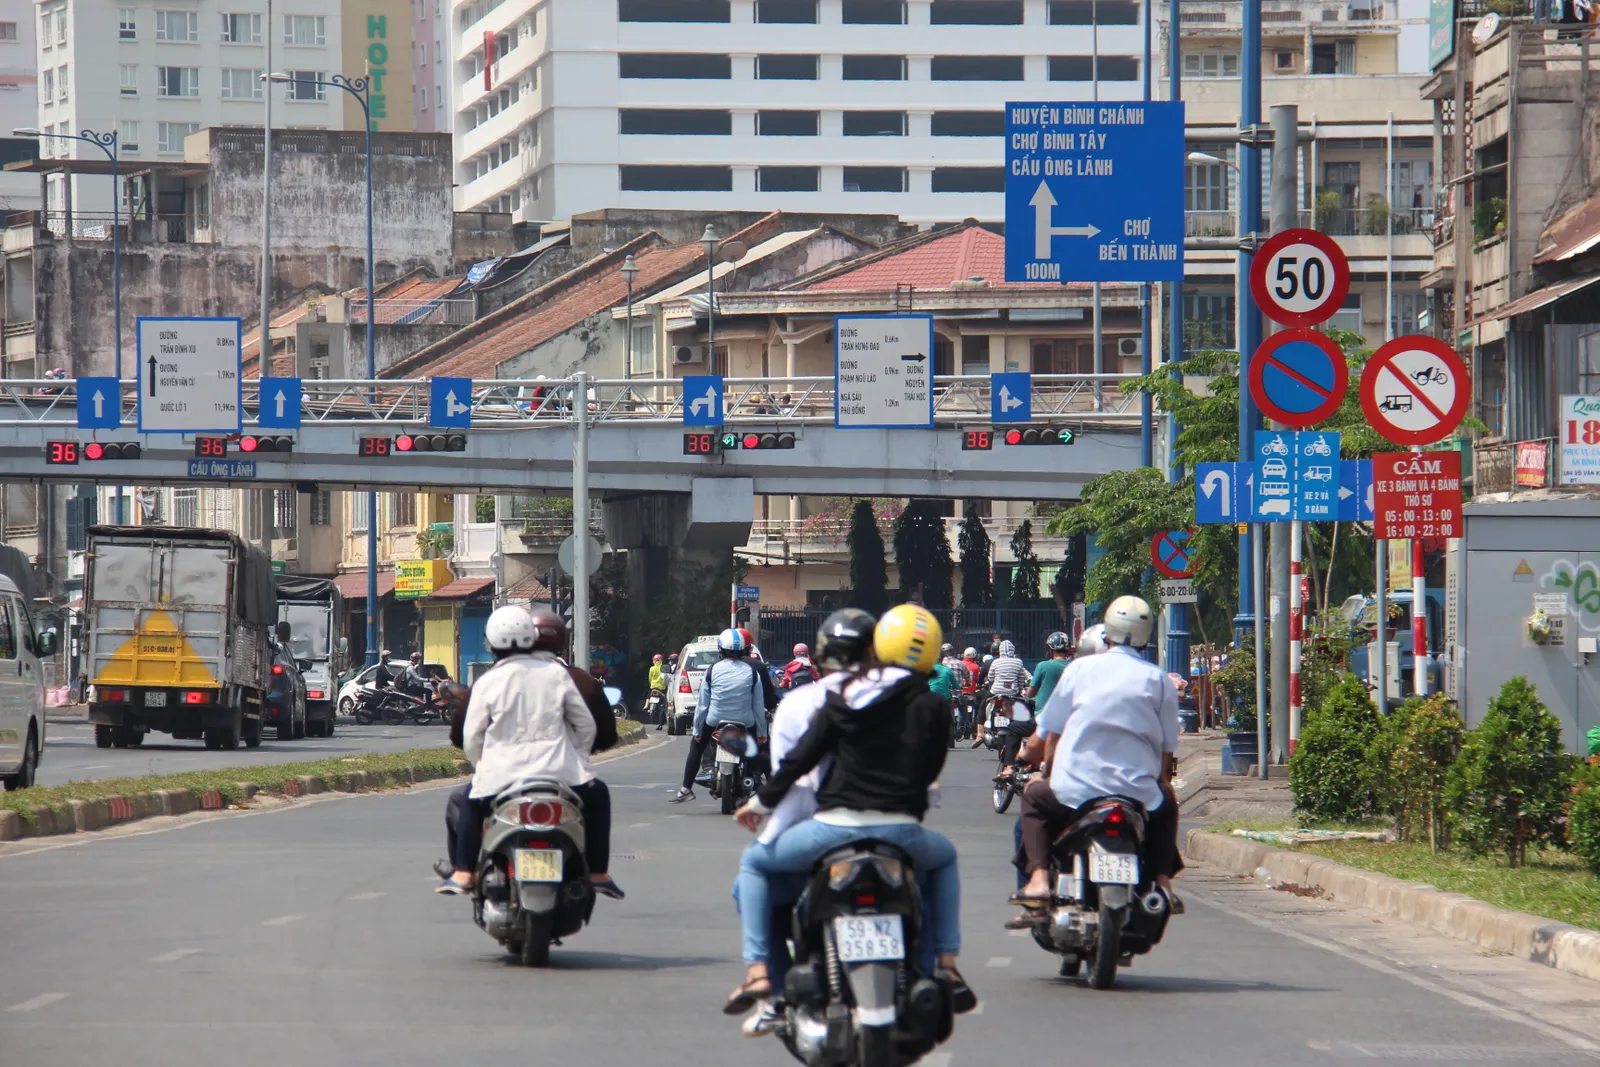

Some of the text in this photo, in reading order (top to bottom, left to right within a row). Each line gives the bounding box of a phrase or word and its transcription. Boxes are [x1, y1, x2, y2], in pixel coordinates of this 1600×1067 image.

[1012, 105, 1144, 128] HUYỆN BÌNH CHÁNH
[1012, 130, 1106, 154] CHỢ BÌNH TÂY
[1044, 156, 1072, 176] ÔNG
[1078, 156, 1112, 176] LÃNH
[1124, 217, 1151, 240] CHỢ
[1100, 238, 1177, 260] BẾN THÀNH
[1024, 263, 1060, 280] 100M
[1275, 257, 1325, 300] 50
[201, 438, 224, 456] 36
[365, 438, 387, 454] 36
[688, 435, 710, 452] 36
[967, 432, 989, 448] 36
[52, 443, 76, 462] 36
[211, 461, 228, 476] ÔNG
[1377, 476, 1459, 492] XE 3 BÁNH VÀ 4 BÁNH
[1315, 492, 1319, 500] 2
[1305, 505, 1310, 513] 3
